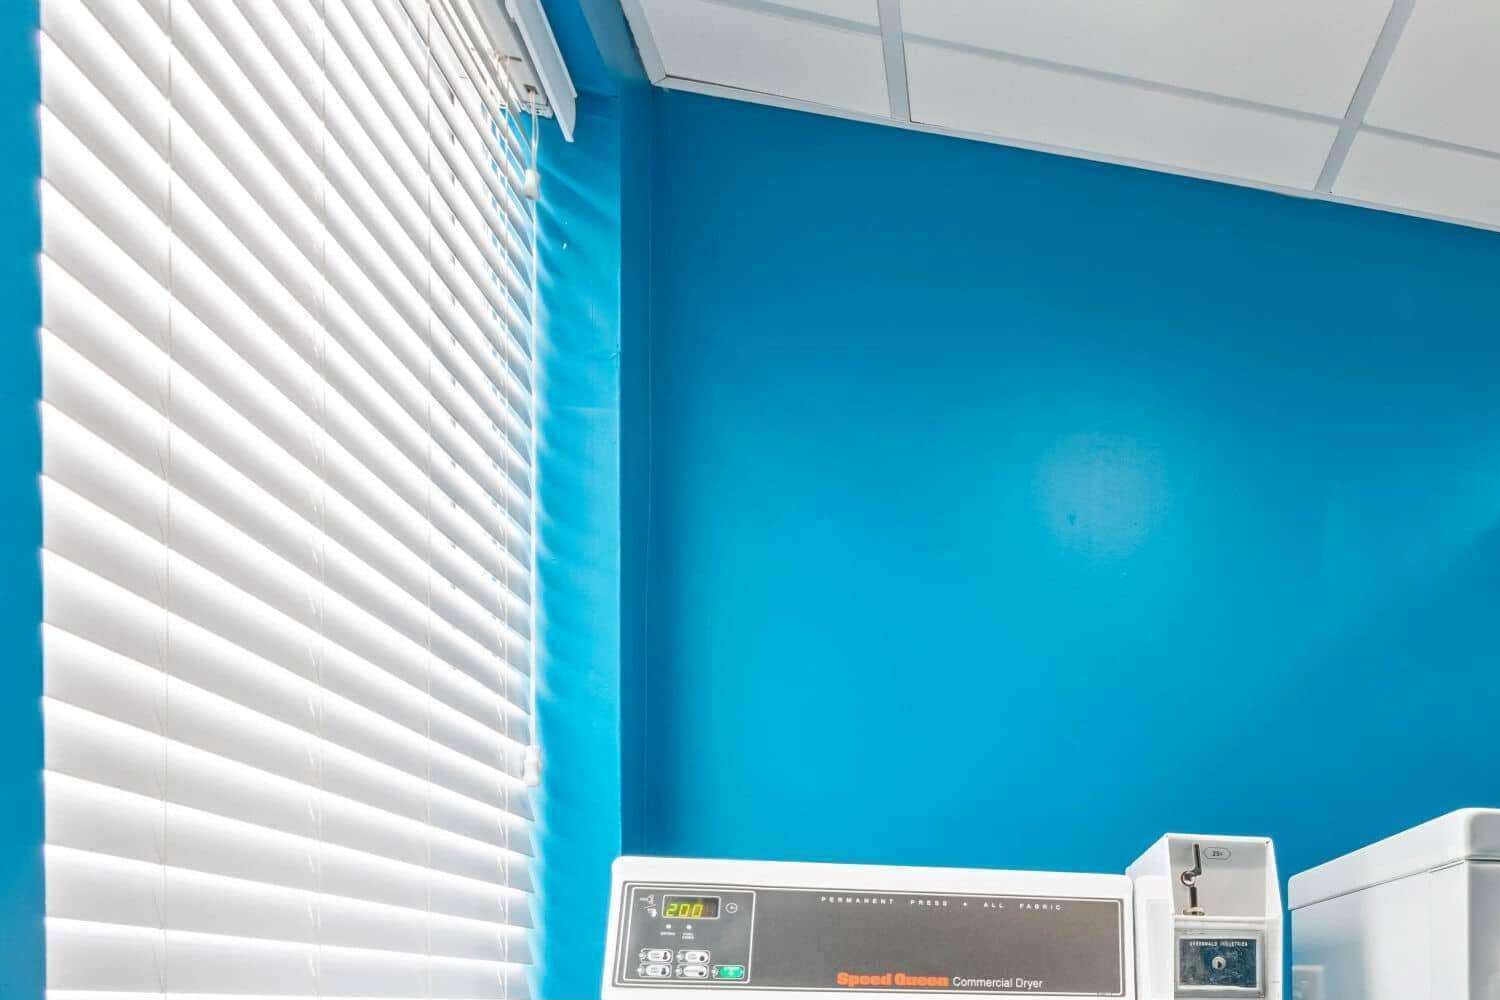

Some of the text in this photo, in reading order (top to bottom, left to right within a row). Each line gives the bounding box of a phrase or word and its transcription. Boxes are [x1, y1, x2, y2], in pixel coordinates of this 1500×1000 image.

[821, 896, 894, 905] PERMANENT
[666, 903, 704, 917] 200
[836, 972, 950, 987] Speed Queen
[952, 976, 1044, 990] Commercial Dryer
